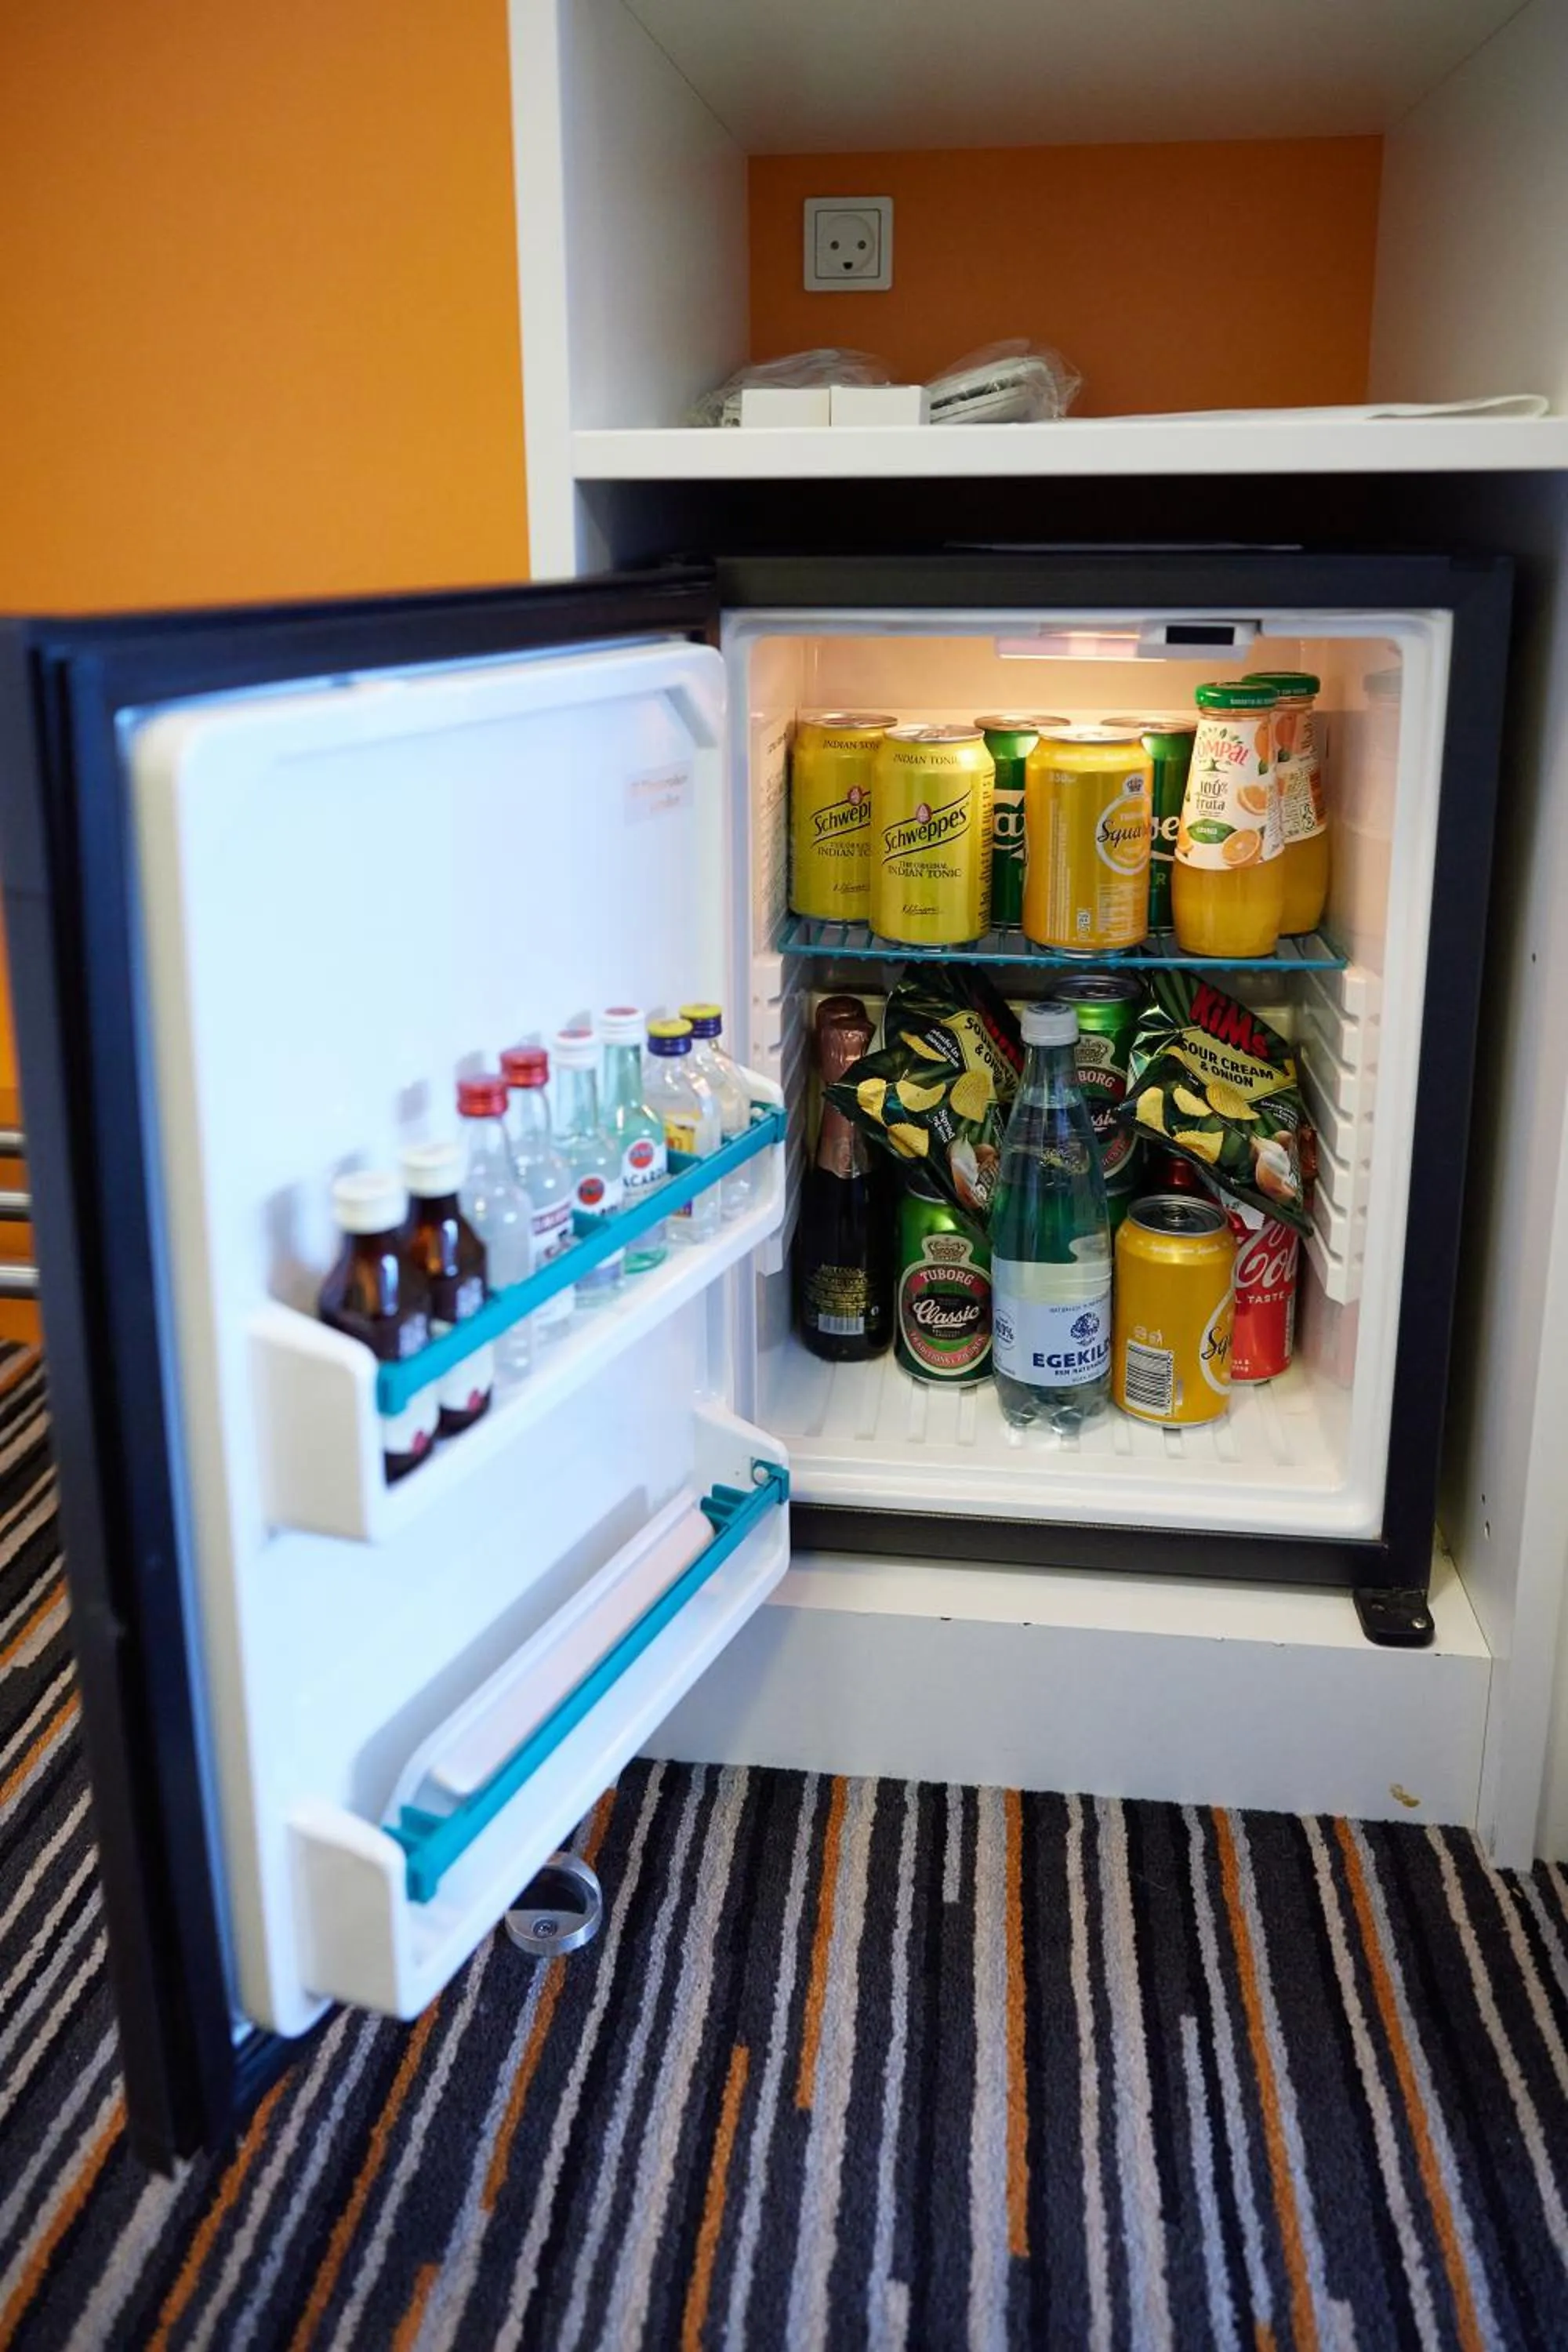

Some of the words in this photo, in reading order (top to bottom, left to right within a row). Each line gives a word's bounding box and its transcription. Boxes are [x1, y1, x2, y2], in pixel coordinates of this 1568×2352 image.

[884, 806, 967, 854] Schweppes
[888, 867, 924, 878] INDIAN
[928, 867, 962, 880] TONIC
[1180, 1037, 1219, 1065] SOUR
[1221, 1058, 1275, 1081] CREAM
[1076, 1070, 1116, 1088] BORG
[1200, 1061, 1209, 1072] &
[1210, 1065, 1254, 1088] ONION
[920, 1269, 975, 1286] TUBORG
[1247, 1291, 1285, 1305] TASTE
[913, 1298, 980, 1325] Classic
